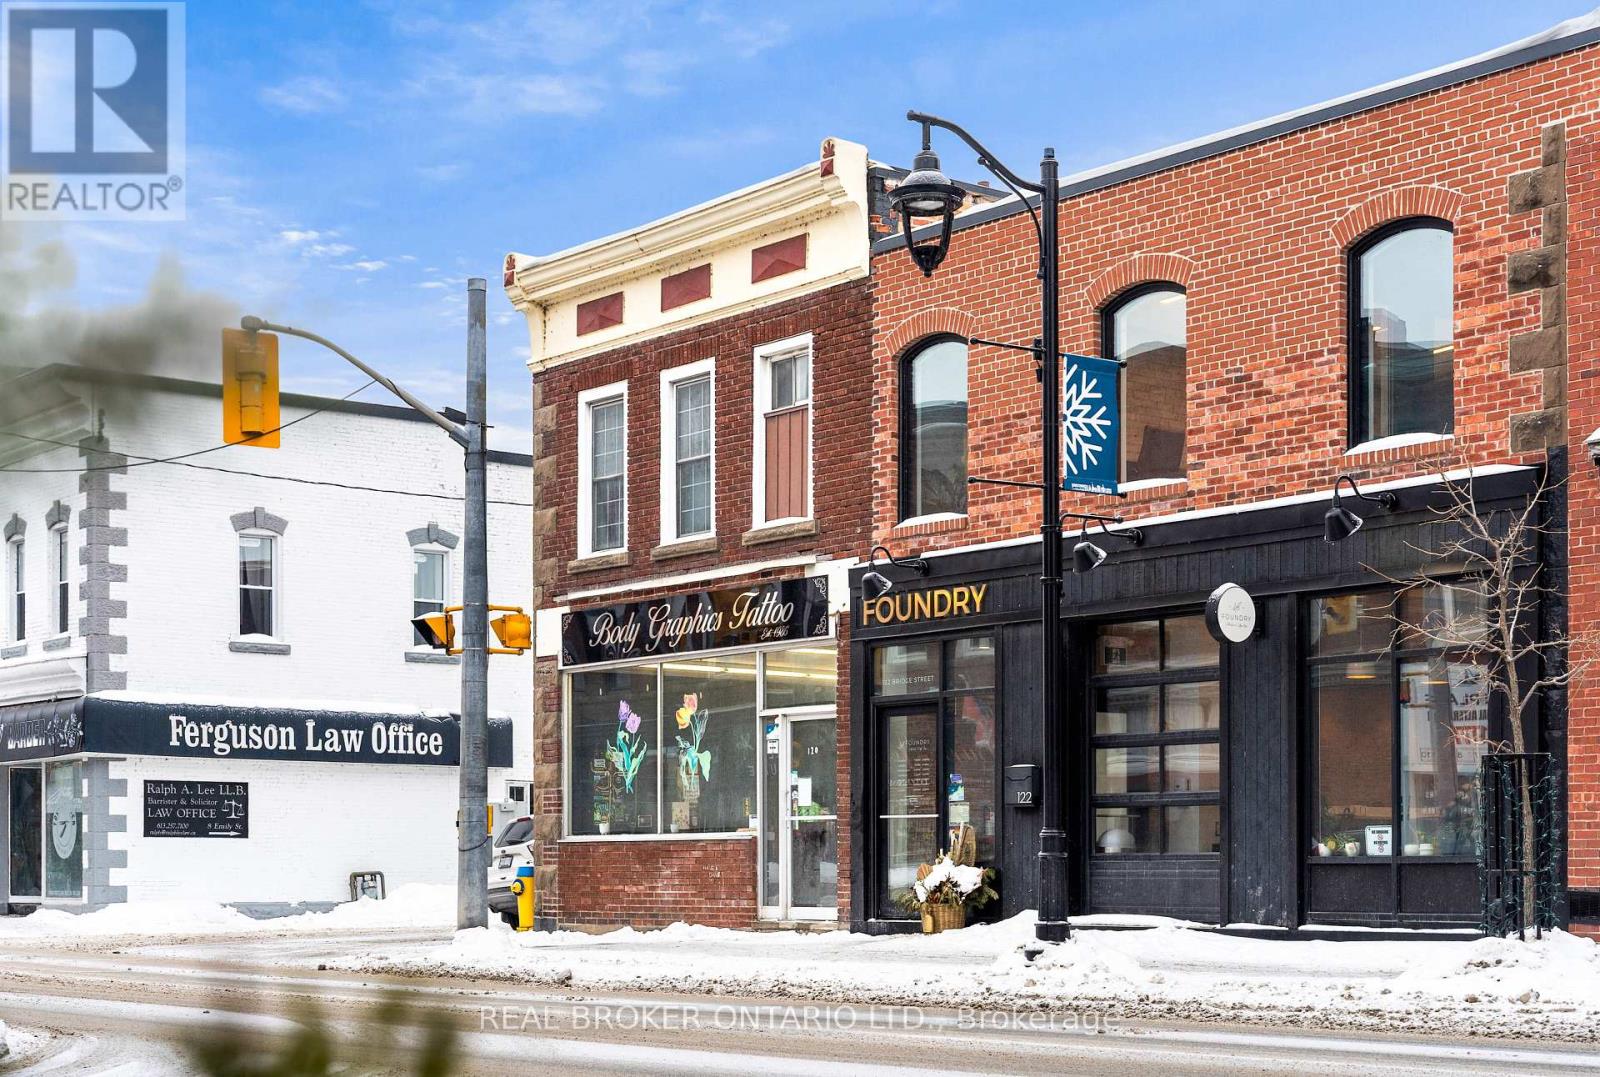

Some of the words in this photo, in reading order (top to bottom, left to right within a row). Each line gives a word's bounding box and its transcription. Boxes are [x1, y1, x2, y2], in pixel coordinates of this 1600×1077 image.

[863, 583, 987, 626] FOUNDRY
[588, 612, 641, 654] Body
[645, 603, 724, 652] Graphics
[728, 591, 795, 629] Tattoo
[168, 714, 297, 756] Ferguson
[304, 719, 365, 753] Law
[371, 722, 444, 756] Office
[807, 746, 819, 756] 120
[147, 783, 177, 796] Ralph
[181, 784, 194, 795] A.
[197, 784, 215, 795] Lee
[219, 784, 247, 795] LL.B.
[147, 797, 178, 805] Barrister
[190, 798, 218, 806] Solicitor
[1016, 791, 1032, 804] 122
[147, 807, 174, 818] LAW
[176, 808, 217, 819] OFFICE
[214, 823, 233, 831] Emily
